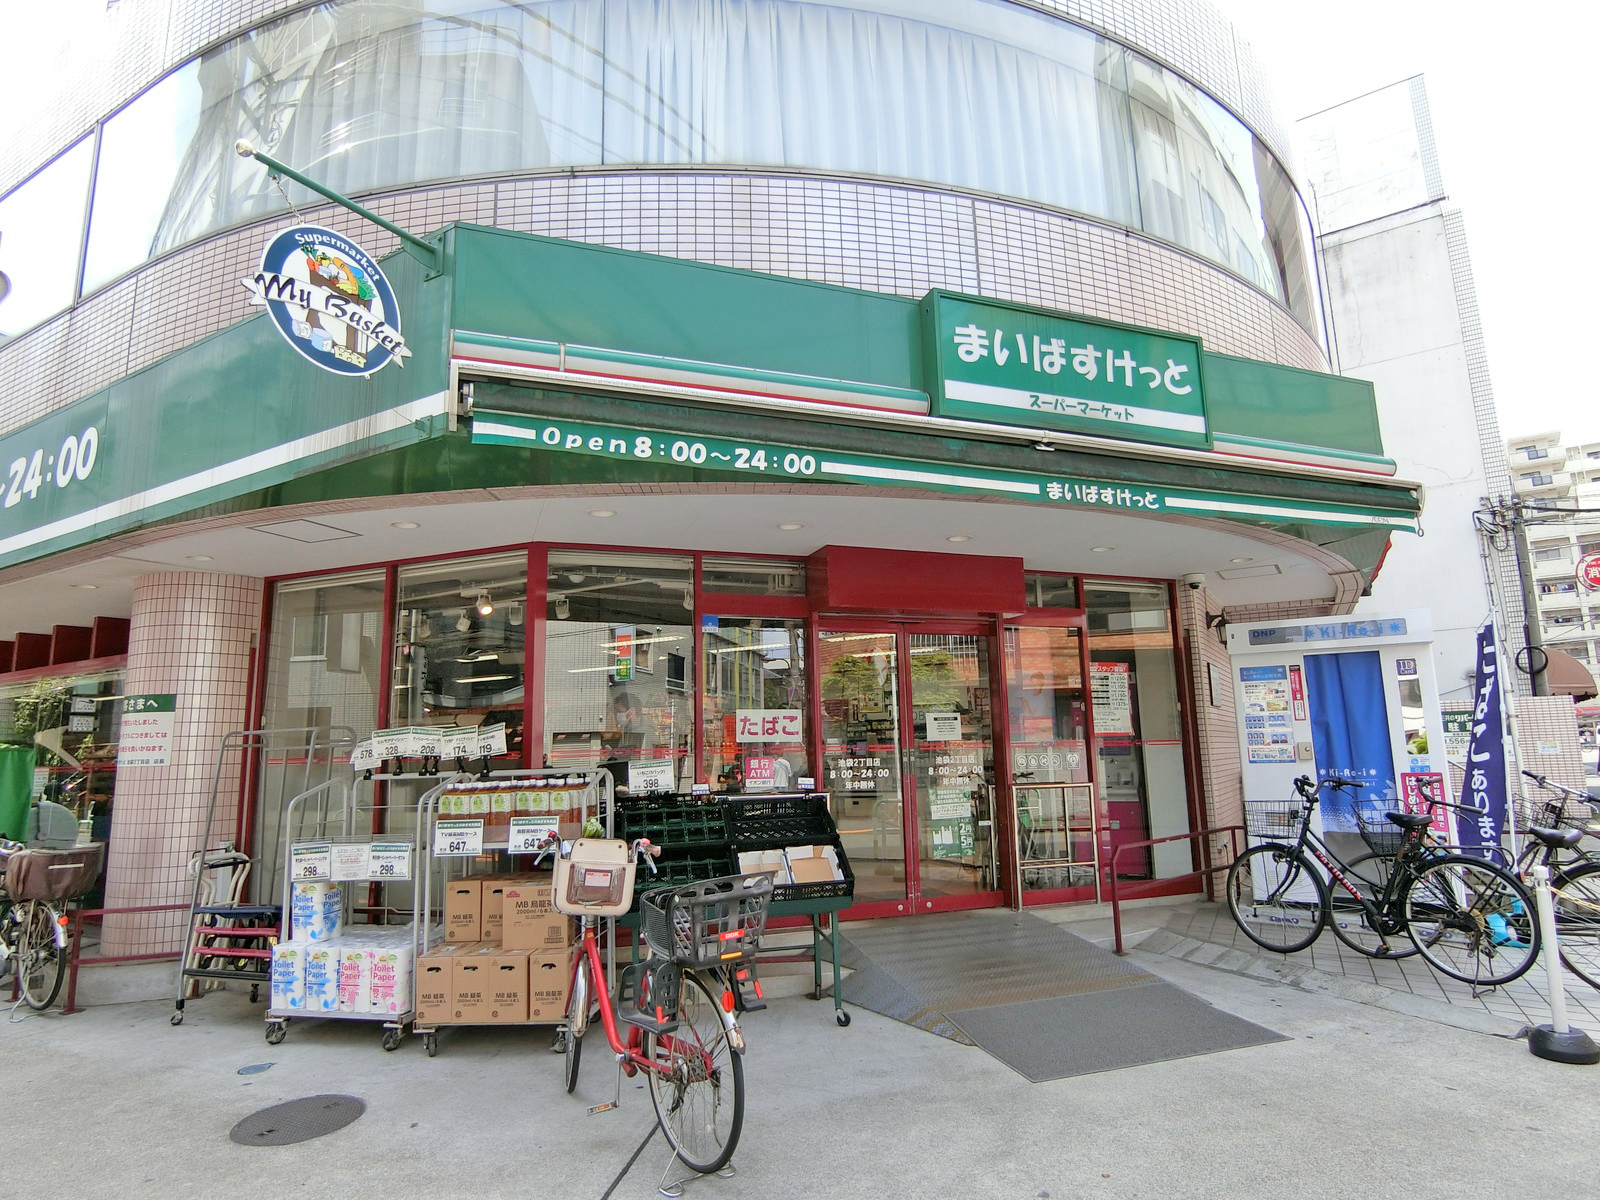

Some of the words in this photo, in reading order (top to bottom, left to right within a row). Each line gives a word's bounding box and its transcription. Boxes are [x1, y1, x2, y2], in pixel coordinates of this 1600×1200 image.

[295, 233, 380, 282] Supermarket
[255, 273, 312, 309] My
[325, 292, 403, 354] Basket
[953, 323, 1193, 395] まいばすけっと
[1029, 394, 1135, 421] スーパーマーケット
[542, 426, 627, 455] Open
[1045, 481, 1160, 509] まいばすけっと
[1586, 566, 1600, 579] 消
[1252, 629, 1276, 638] DNP
[1399, 659, 1414, 669] ID
[740, 715, 799, 736] たばこ
[385, 745, 398, 756] 328
[420, 745, 435, 754] 208
[453, 745, 466, 755] 174
[479, 743, 492, 754] 119
[360, 749, 373, 759] 578
[750, 759, 770, 769] 銀行
[838, 757, 881, 767] 池袋2丁目店
[935, 755, 976, 764] 池袋2丁目店
[749, 769, 770, 778] ATM
[643, 778, 659, 789] 398
[845, 780, 876, 789] 年中無休
[942, 777, 970, 786] 年中無休
[449, 841, 466, 852] 647
[523, 838, 541, 849] 647
[303, 865, 318, 877] 298
[379, 864, 394, 875] 298
[294, 894, 314, 903] Toilet
[324, 890, 342, 901] Toilet
[293, 903, 314, 911] Paper
[323, 899, 342, 909] Paper
[515, 900, 529, 908] MB
[273, 960, 294, 968] Toilet
[308, 961, 326, 970] Toilet
[341, 963, 360, 971] Toilet
[373, 964, 395, 972] Toilet
[273, 969, 295, 977] Paper
[307, 970, 327, 978] Paper
[340, 971, 361, 980] Paper
[372, 973, 396, 981] Paper
